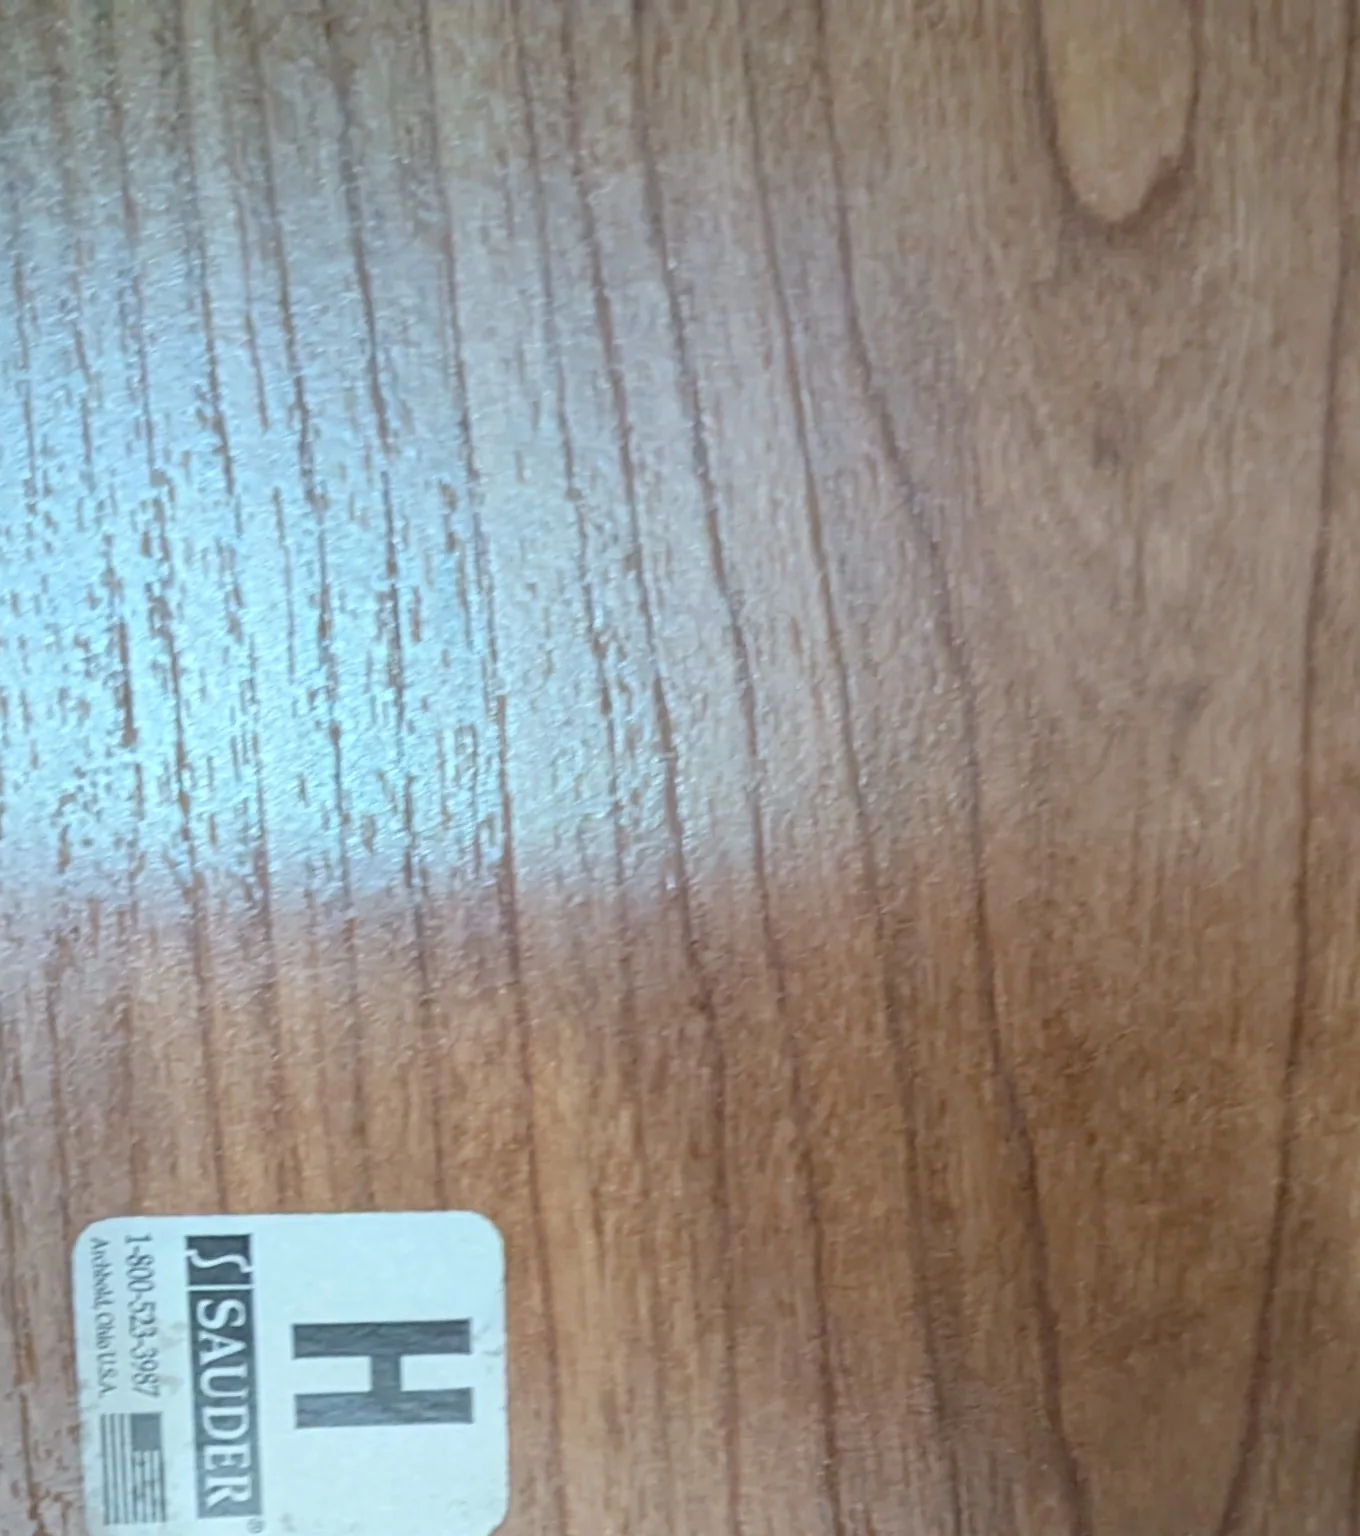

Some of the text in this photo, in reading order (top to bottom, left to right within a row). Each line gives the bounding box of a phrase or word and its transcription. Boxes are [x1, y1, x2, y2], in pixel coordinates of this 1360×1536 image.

[90, 1237, 119, 1311] Archbold,
[125, 1233, 162, 1399] 1-800-523-3987
[94, 1312, 117, 1350] Ohio
[292, 1317, 474, 1429] H
[195, 1299, 253, 1508] SAUDER
